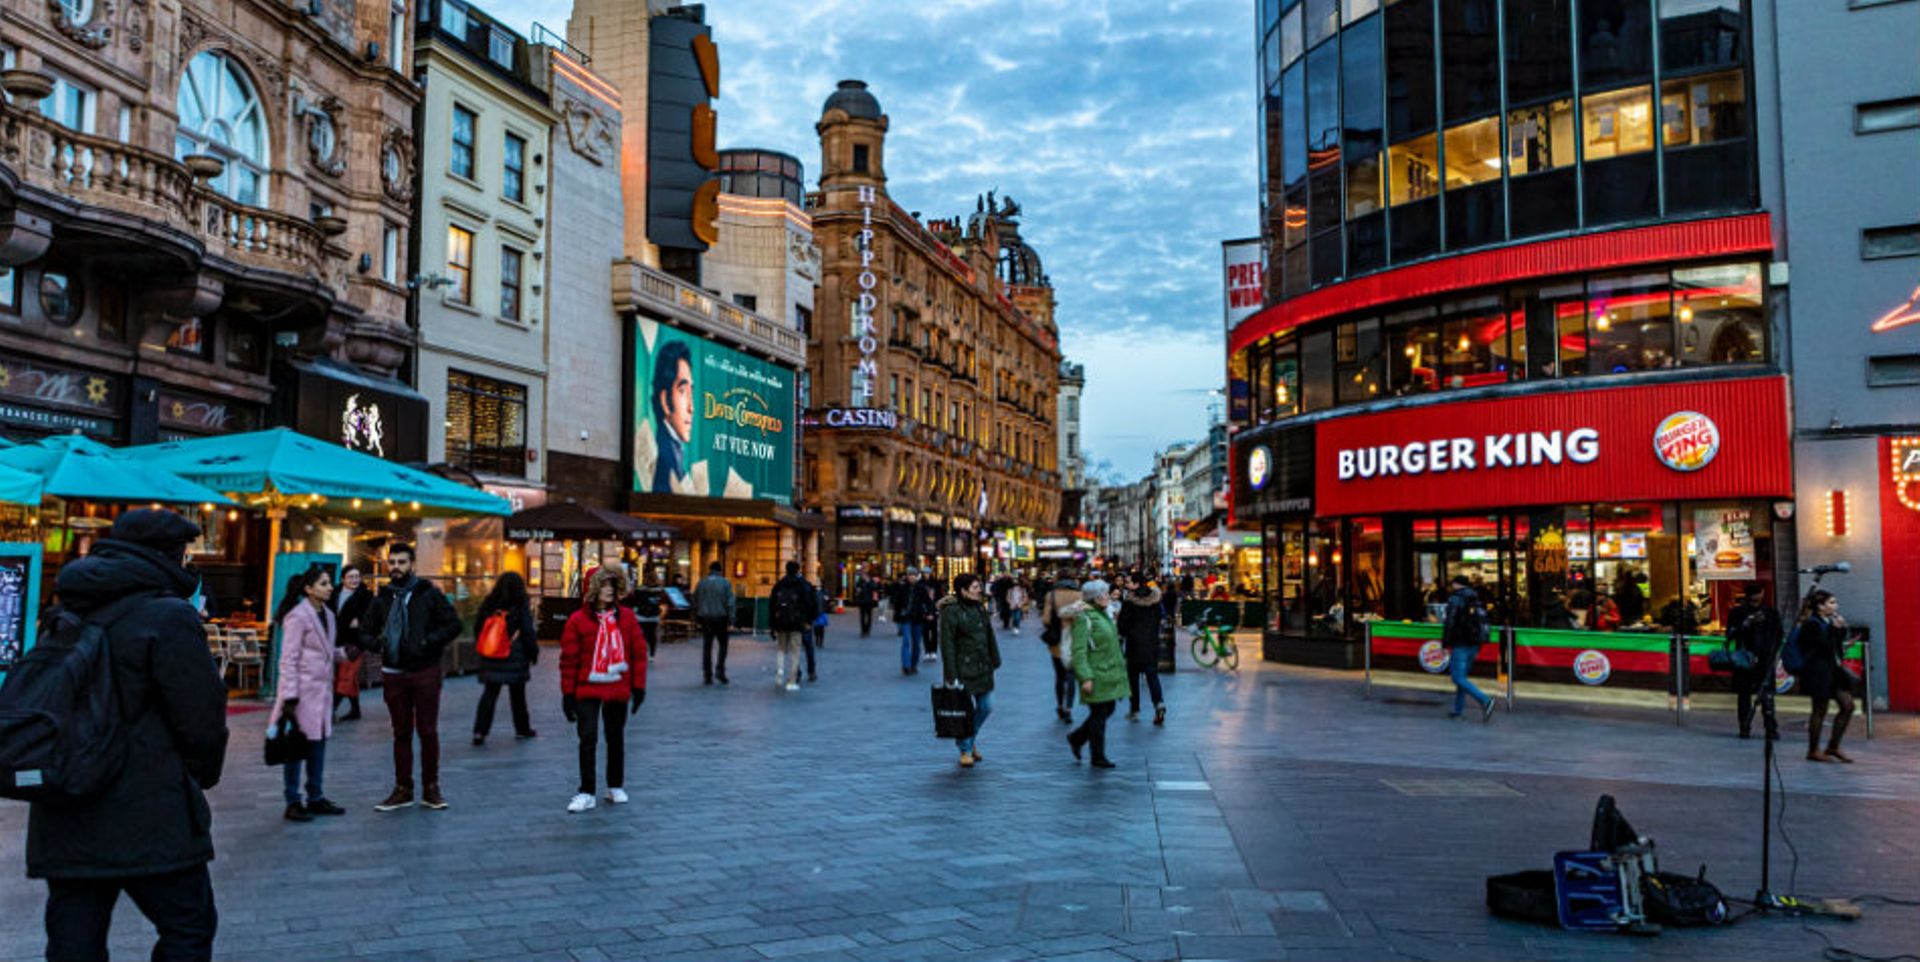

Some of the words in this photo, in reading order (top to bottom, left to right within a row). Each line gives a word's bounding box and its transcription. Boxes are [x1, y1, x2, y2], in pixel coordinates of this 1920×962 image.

[858, 185, 878, 397] HIPPODROME
[826, 408, 896, 428] CASINO
[1657, 419, 1707, 449] BURGER
[712, 433, 728, 452] AT
[728, 435, 750, 457] VUE
[751, 441, 776, 461] NOW
[1338, 437, 1477, 480] BURGER
[1484, 427, 1600, 468] KING
[1661, 427, 1713, 462] KING
